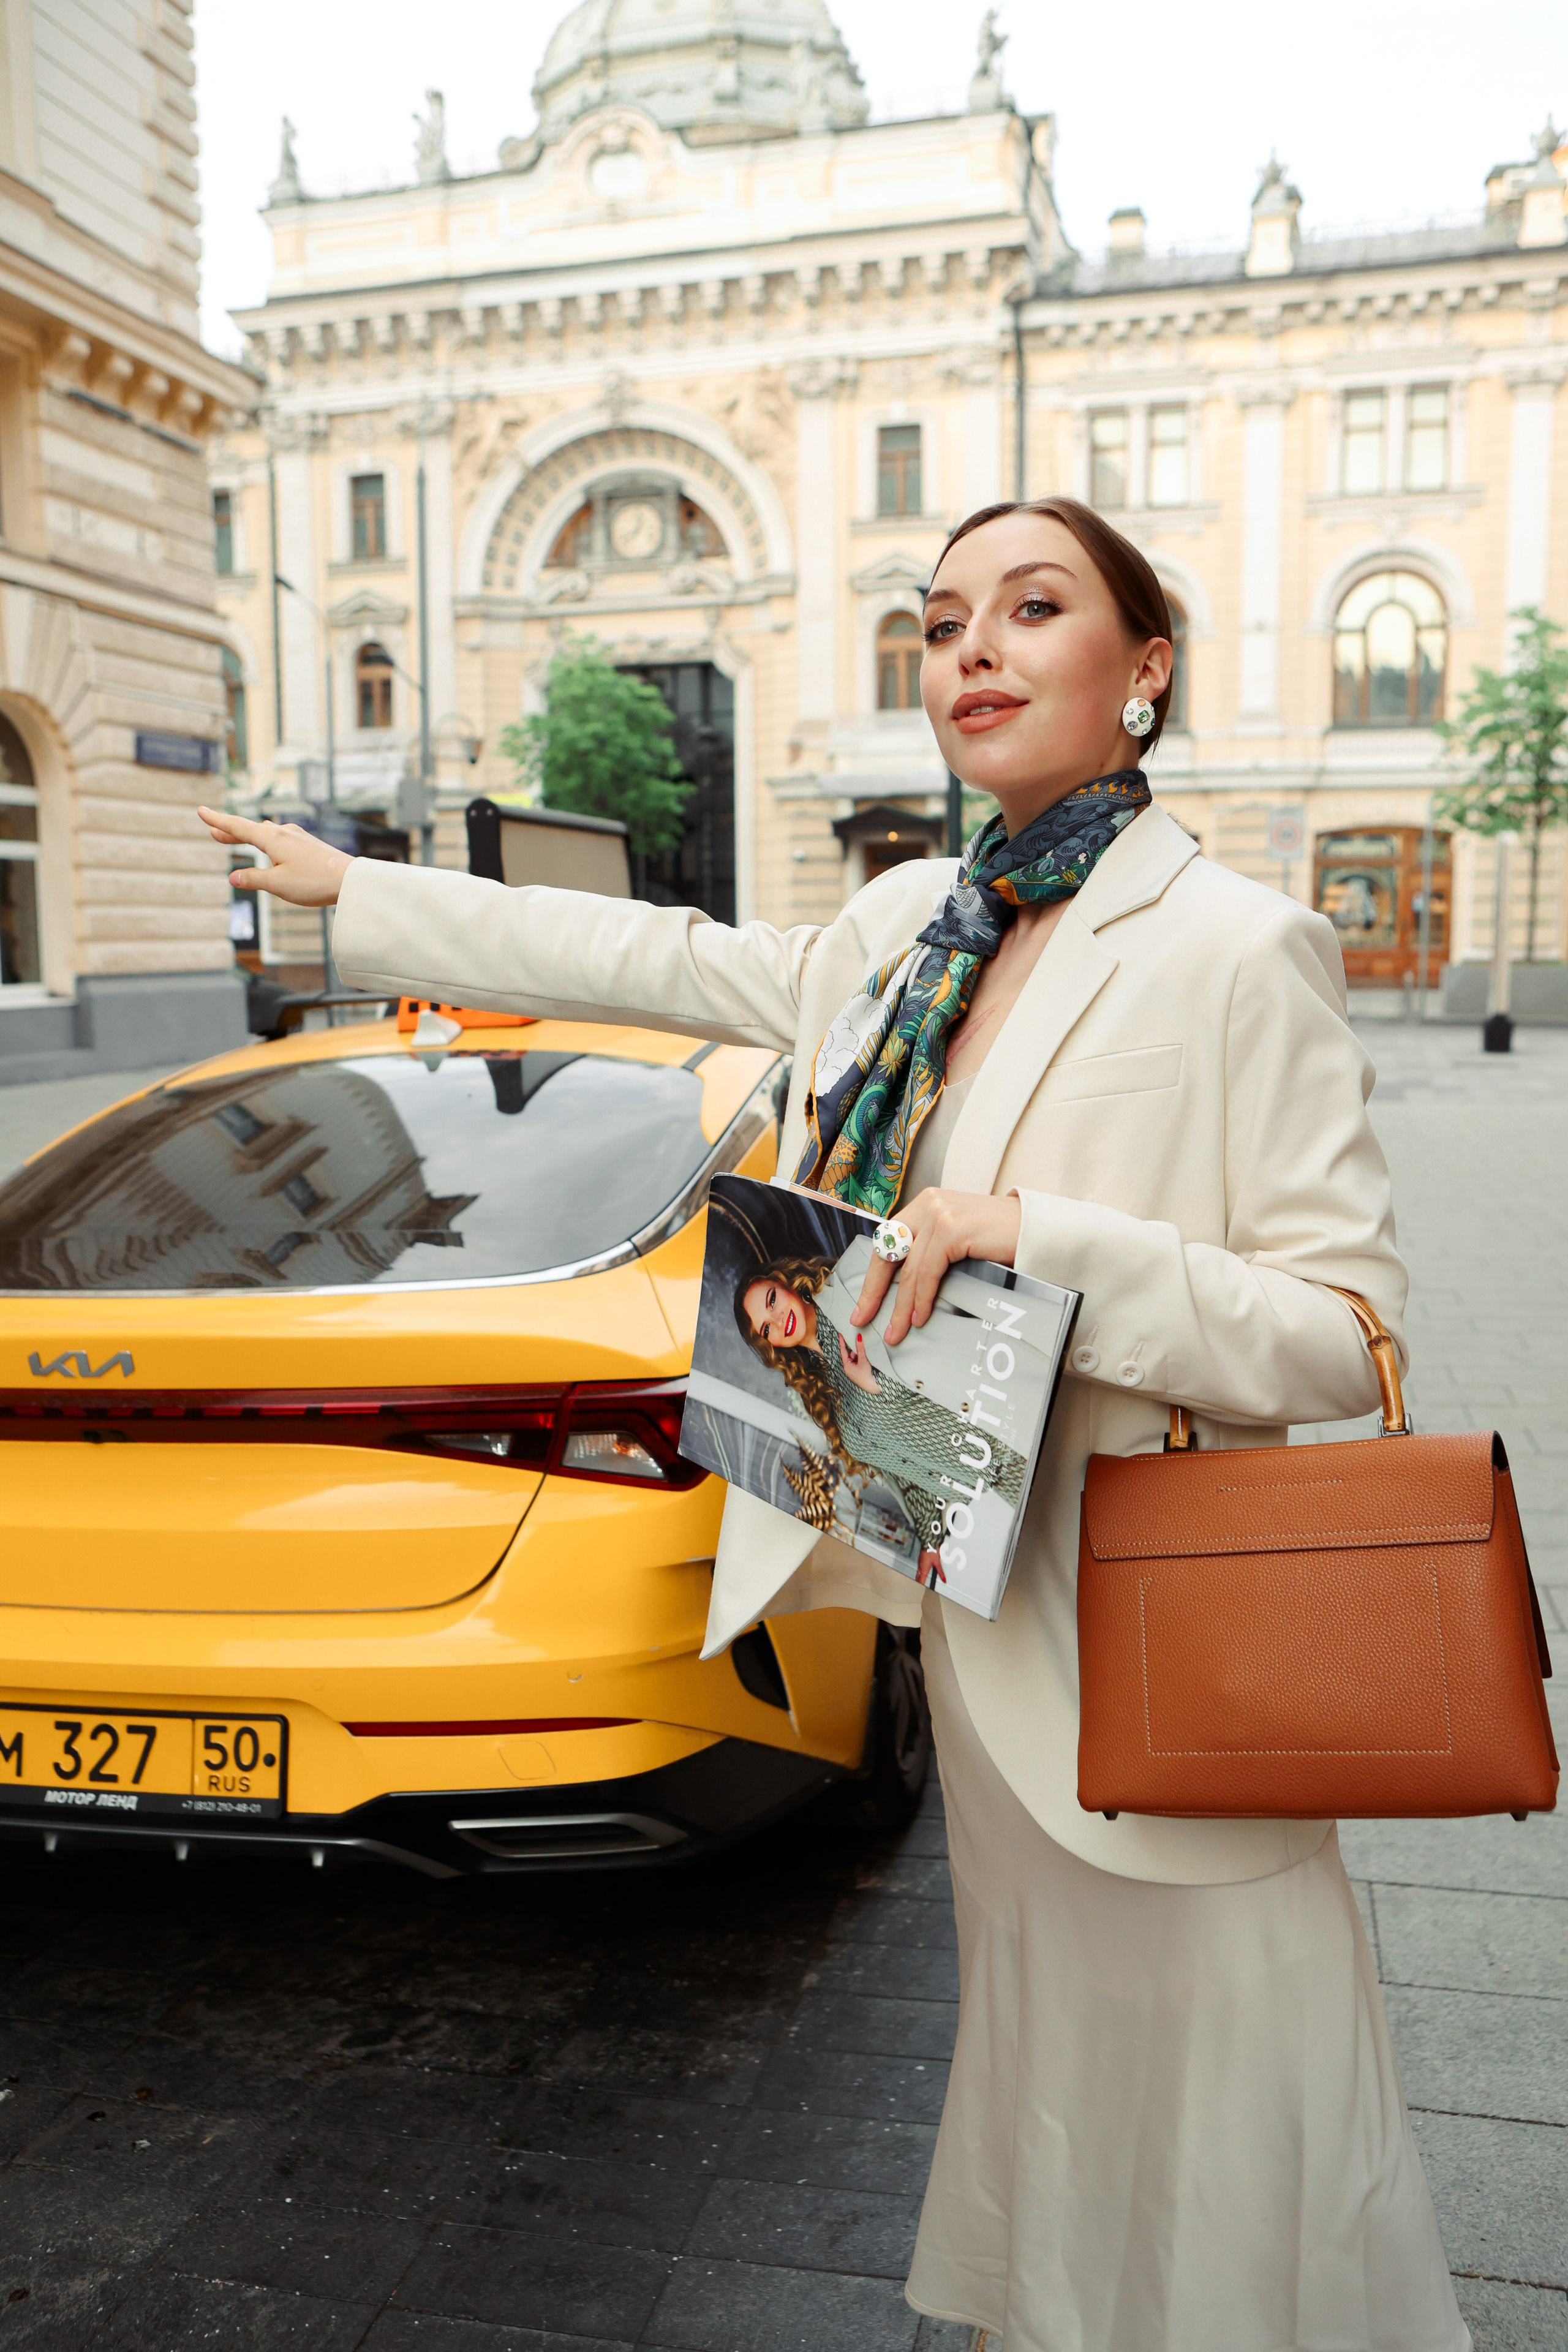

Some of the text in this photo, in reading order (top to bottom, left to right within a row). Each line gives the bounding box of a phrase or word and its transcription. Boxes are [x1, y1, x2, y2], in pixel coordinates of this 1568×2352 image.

[28, 1350, 134, 1378] KIA
[926, 1297, 999, 1554] YOUR CHARTER
[939, 1300, 1027, 1571] SOLUTION
[53, 1721, 157, 1784] 327
[204, 1725, 259, 1772] 50
[44, 1790, 138, 1811] МОТОР ЛЕНД
[208, 1775, 250, 1793] RUS
